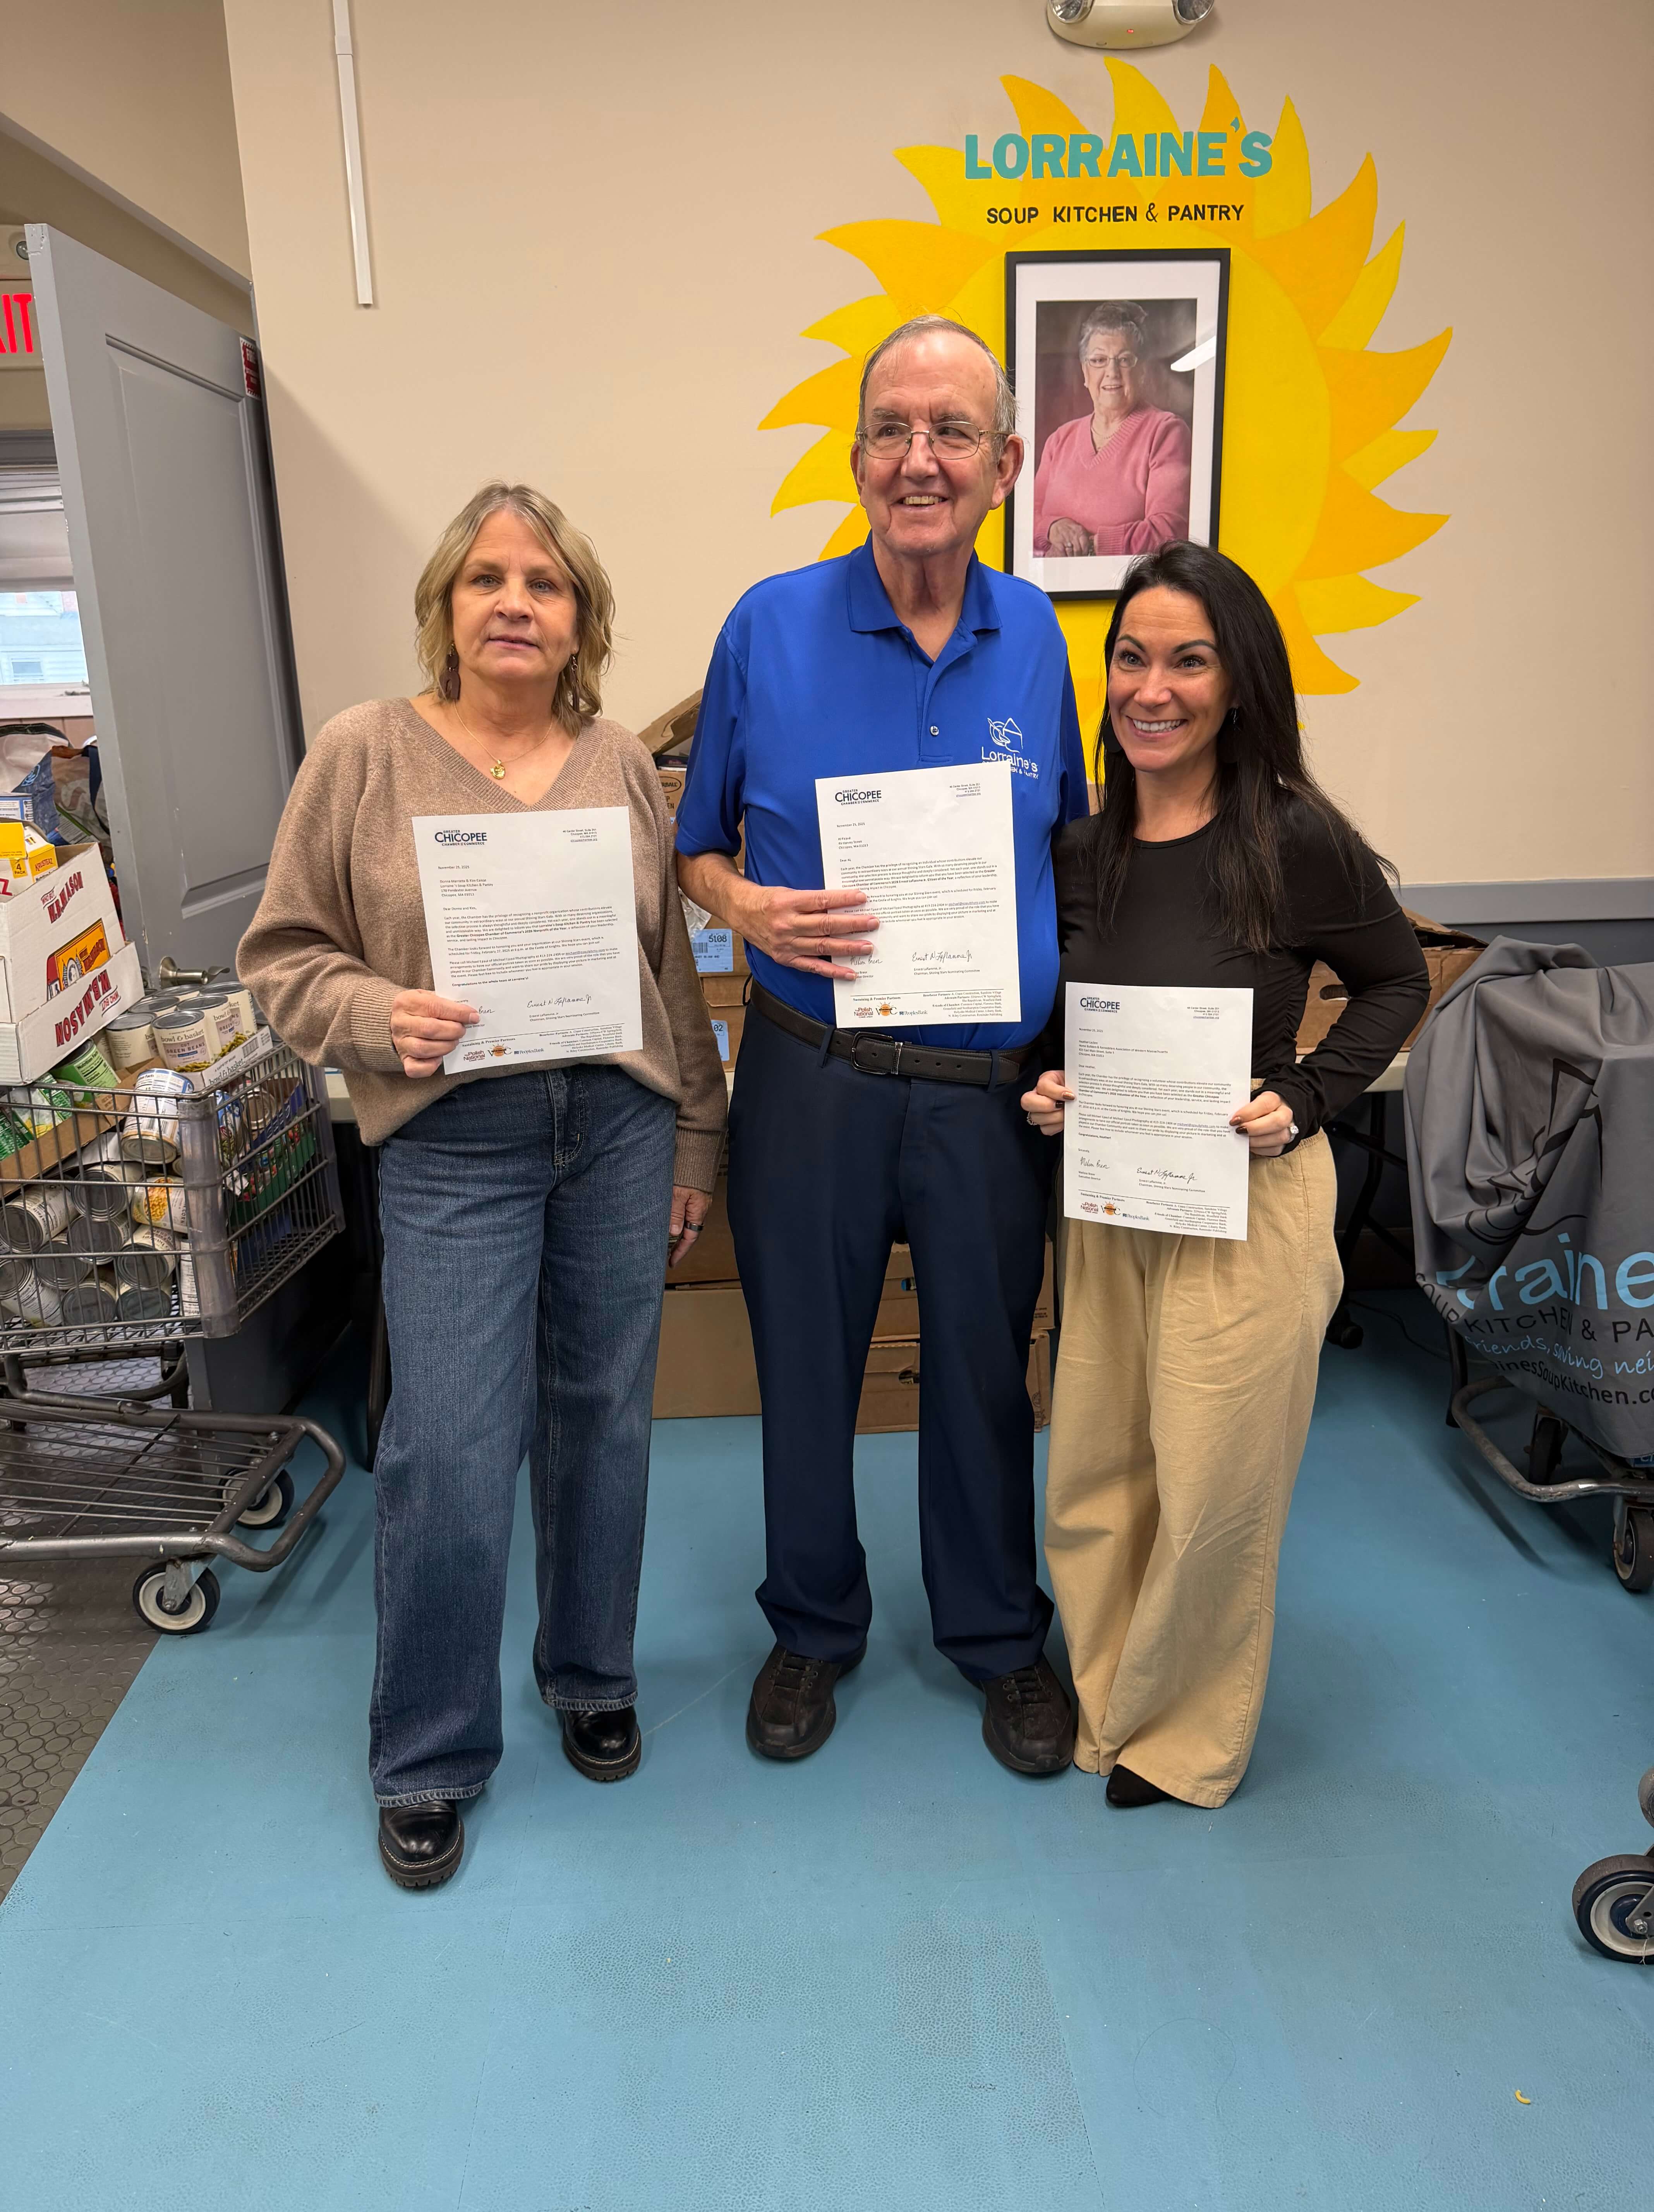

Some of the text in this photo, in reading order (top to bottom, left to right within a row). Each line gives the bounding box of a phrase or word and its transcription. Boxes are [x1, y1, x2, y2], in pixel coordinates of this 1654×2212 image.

[965, 120, 1273, 179] LORRAINE'S
[986, 202, 1245, 224] SOUP KITCHEN & PANTRY
[981, 747, 1038, 772] Lorraine's
[835, 790, 882, 802] CHICOPEE
[435, 832, 487, 843] CHICOPEE
[35, 858, 53, 871] KRUSTEAZ
[1080, 998, 1120, 1010] CHICOPEE
[184, 1029, 204, 1040] basket
[188, 1042, 205, 1051] BEANS
[1463, 1306, 1573, 1335] KITCHEN
[1581, 1319, 1597, 1342] &
